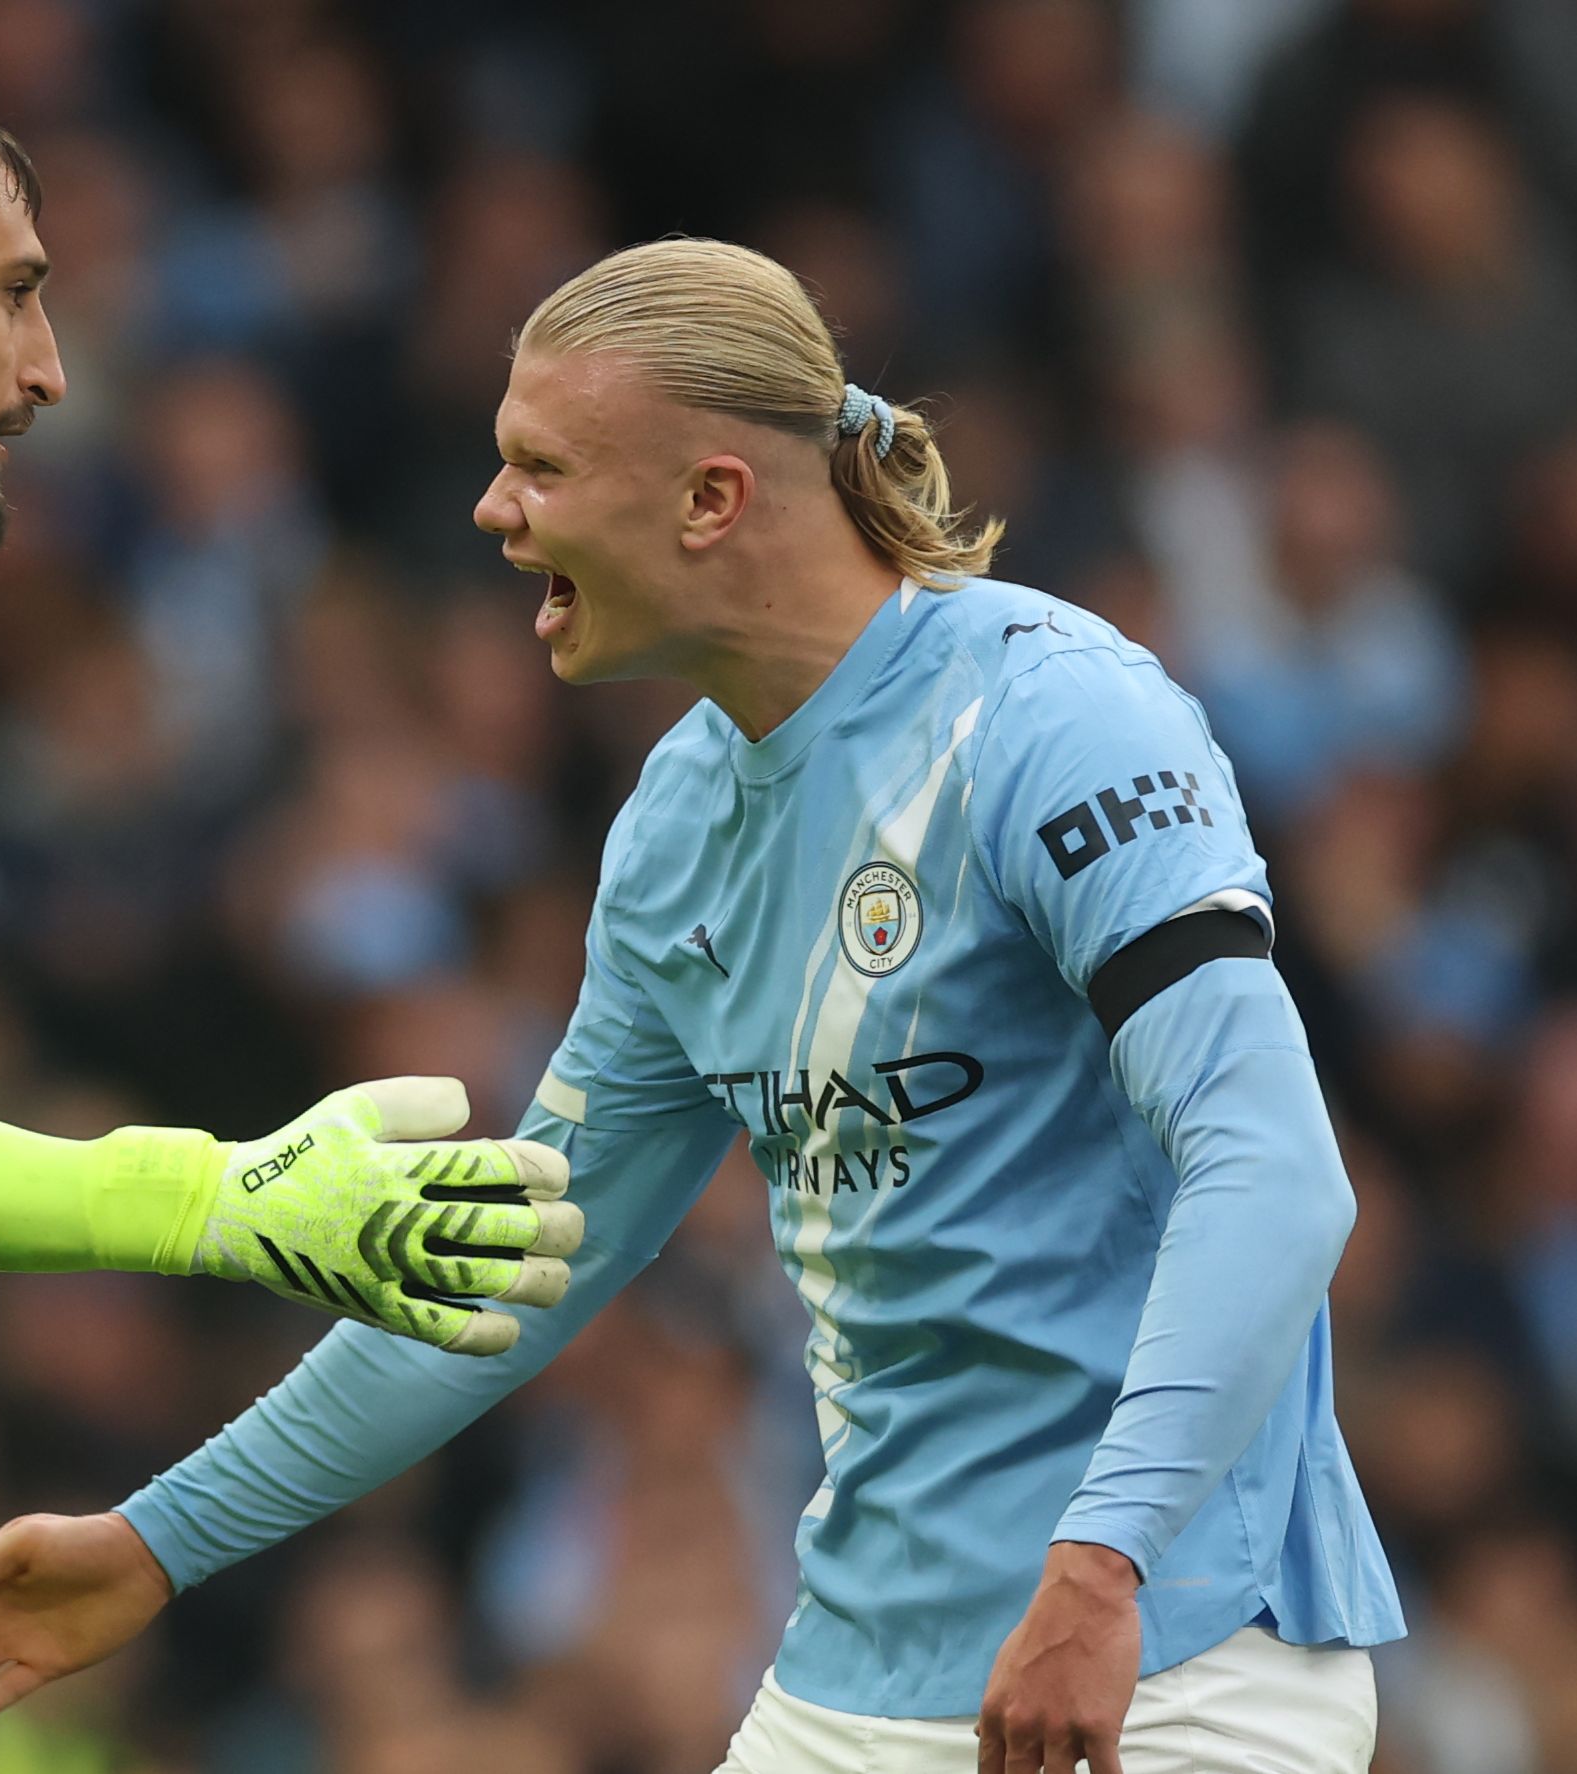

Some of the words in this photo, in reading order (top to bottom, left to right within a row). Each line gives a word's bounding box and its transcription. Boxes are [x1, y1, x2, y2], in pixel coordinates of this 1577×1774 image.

[846, 871, 912, 909] MANCHESTER
[869, 956, 894, 969] CITY
[702, 1051, 985, 1136] TIHAD
[241, 1132, 315, 1193] PRED
